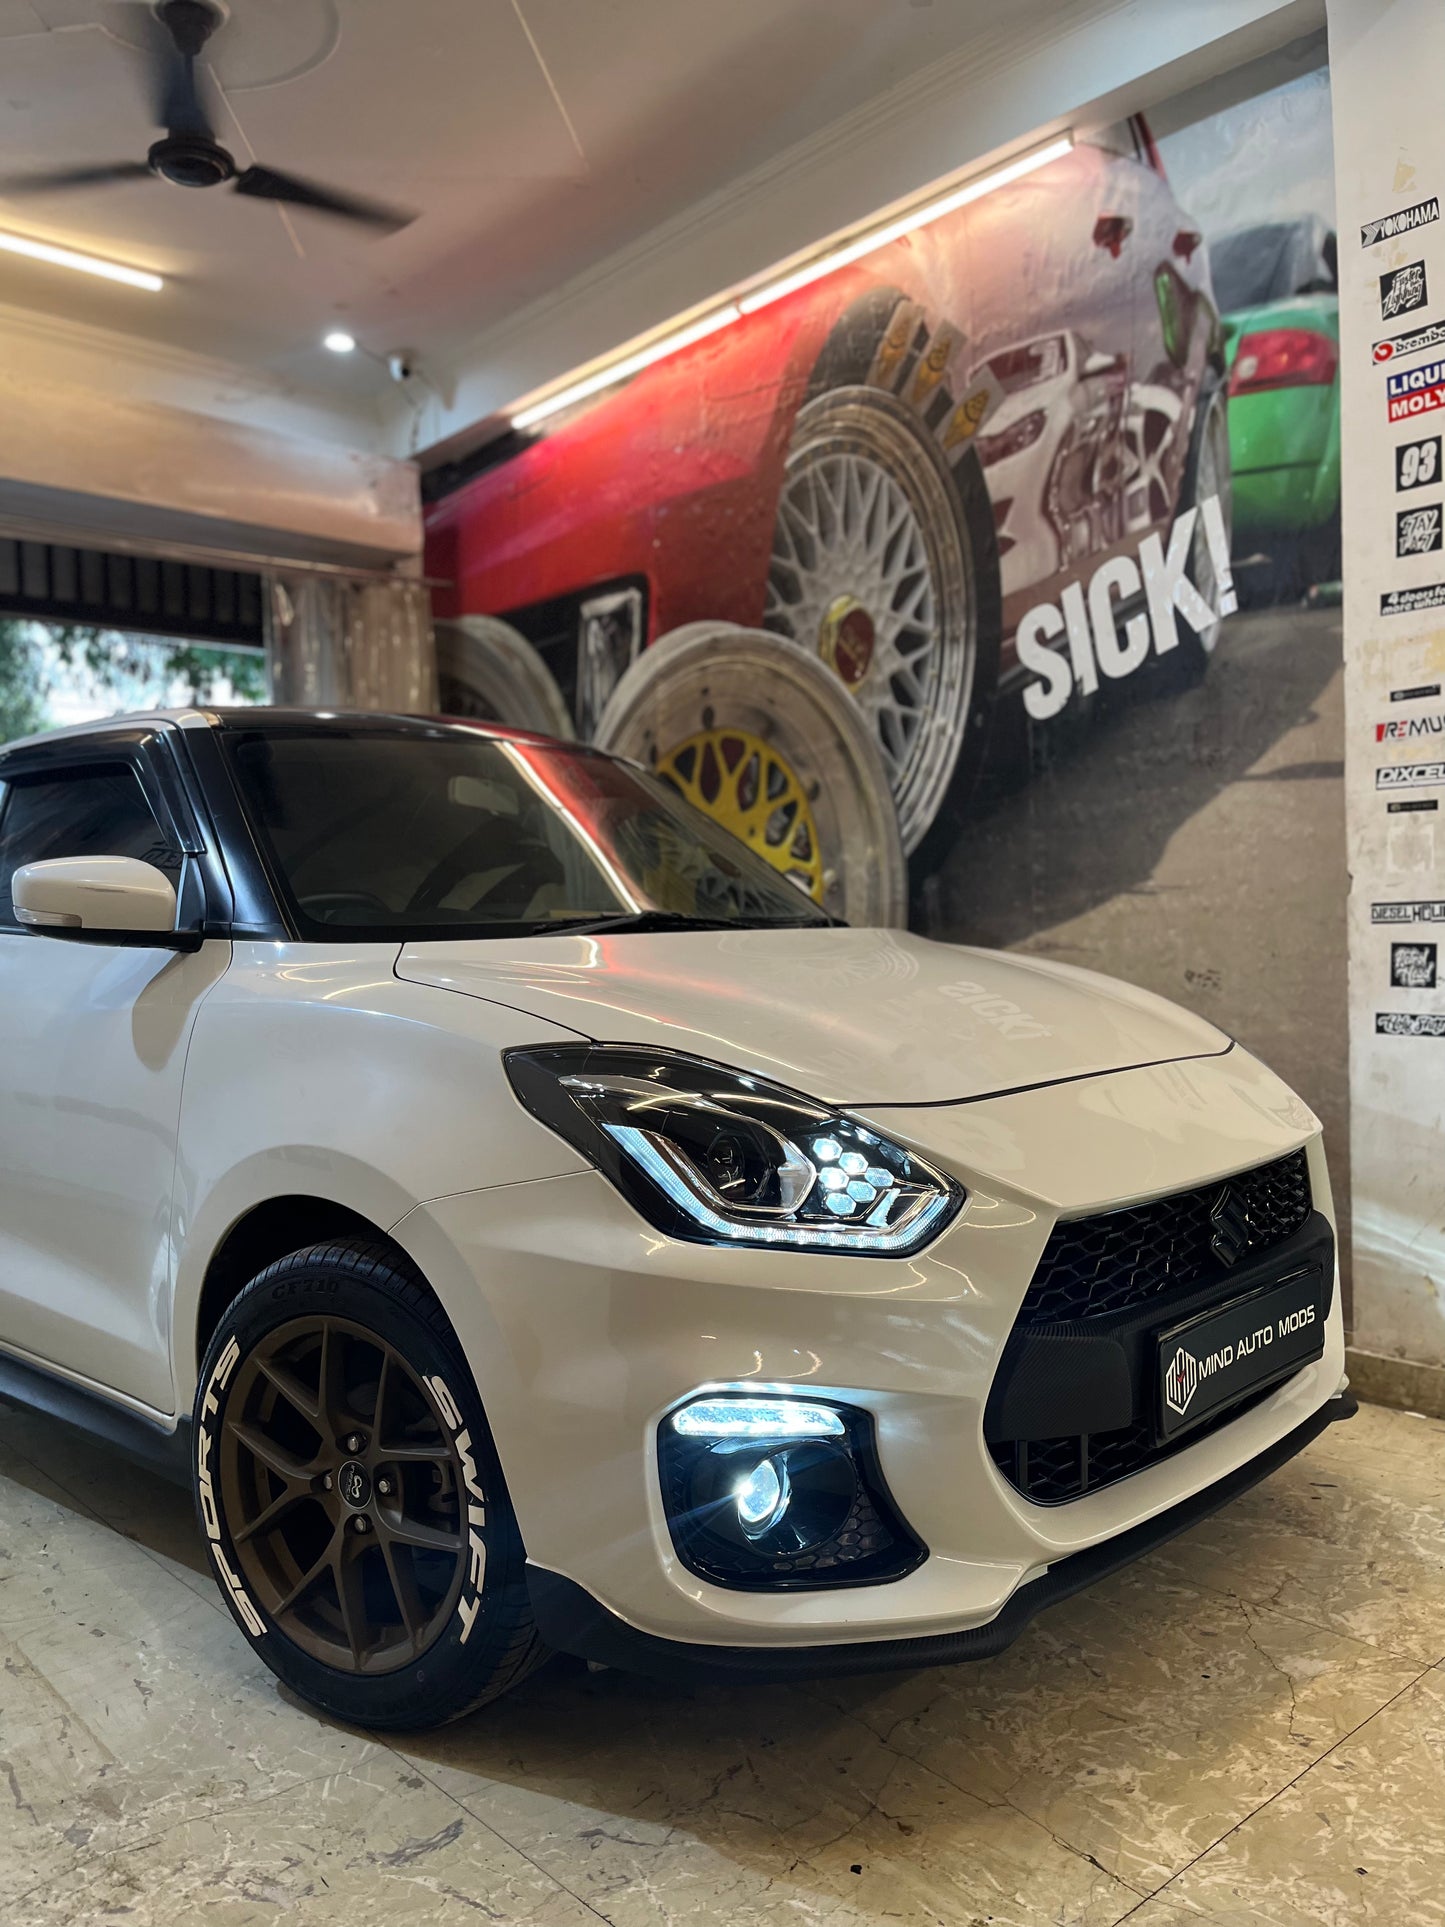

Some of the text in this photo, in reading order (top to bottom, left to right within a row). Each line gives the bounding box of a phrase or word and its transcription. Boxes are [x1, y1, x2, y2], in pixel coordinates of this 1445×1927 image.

[1379, 202, 1439, 239] YOKOHAMA
[1391, 389, 1445, 419] MOLY
[1400, 441, 1437, 487] 93
[1016, 494, 1238, 720] SICK!
[1385, 715, 1445, 738] REMU
[1198, 1304, 1315, 1381] MIND AUTO MODS
[198, 1335, 267, 1637] SPORTS
[422, 1375, 487, 1645] SWIFT
